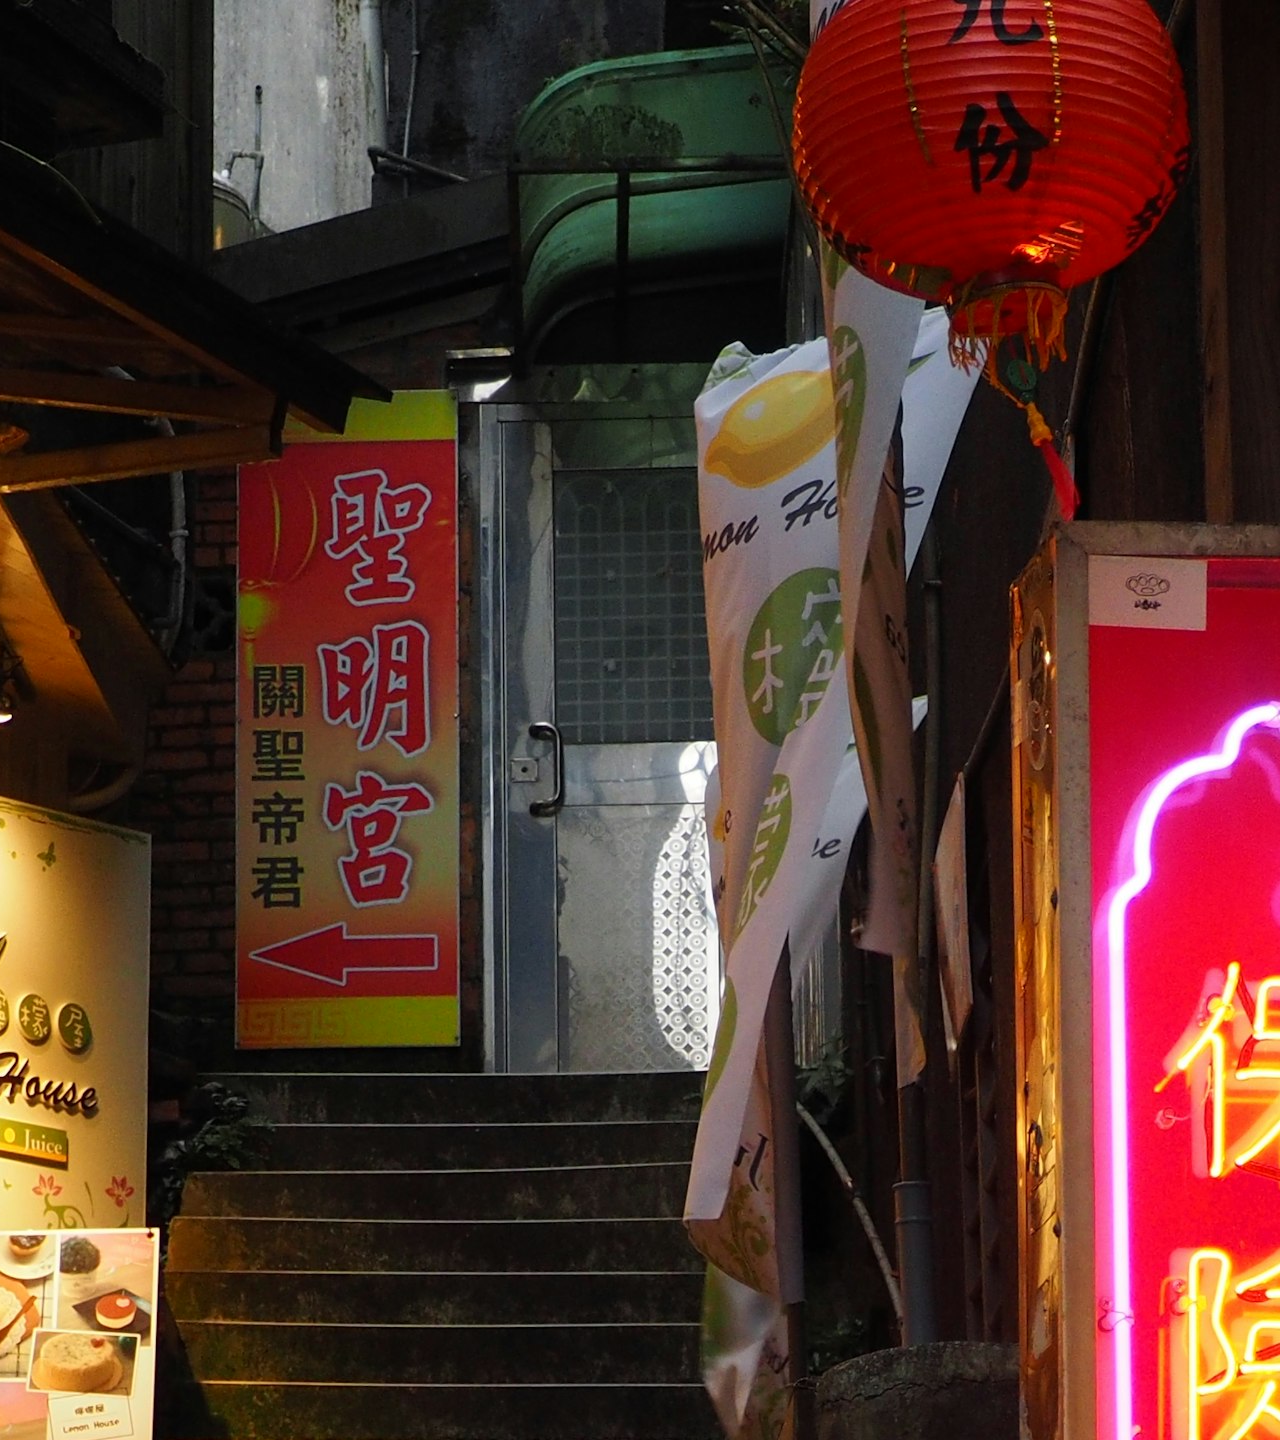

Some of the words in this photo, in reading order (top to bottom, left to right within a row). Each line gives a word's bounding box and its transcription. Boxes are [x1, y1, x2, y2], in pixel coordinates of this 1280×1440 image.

[317, 468, 434, 909] 聖明宮
[251, 665, 305, 909] 關聖帝君
[24, 1128, 63, 1156] Juice
[62, 1422, 91, 1434] Lemon
[94, 1417, 120, 1429] House
